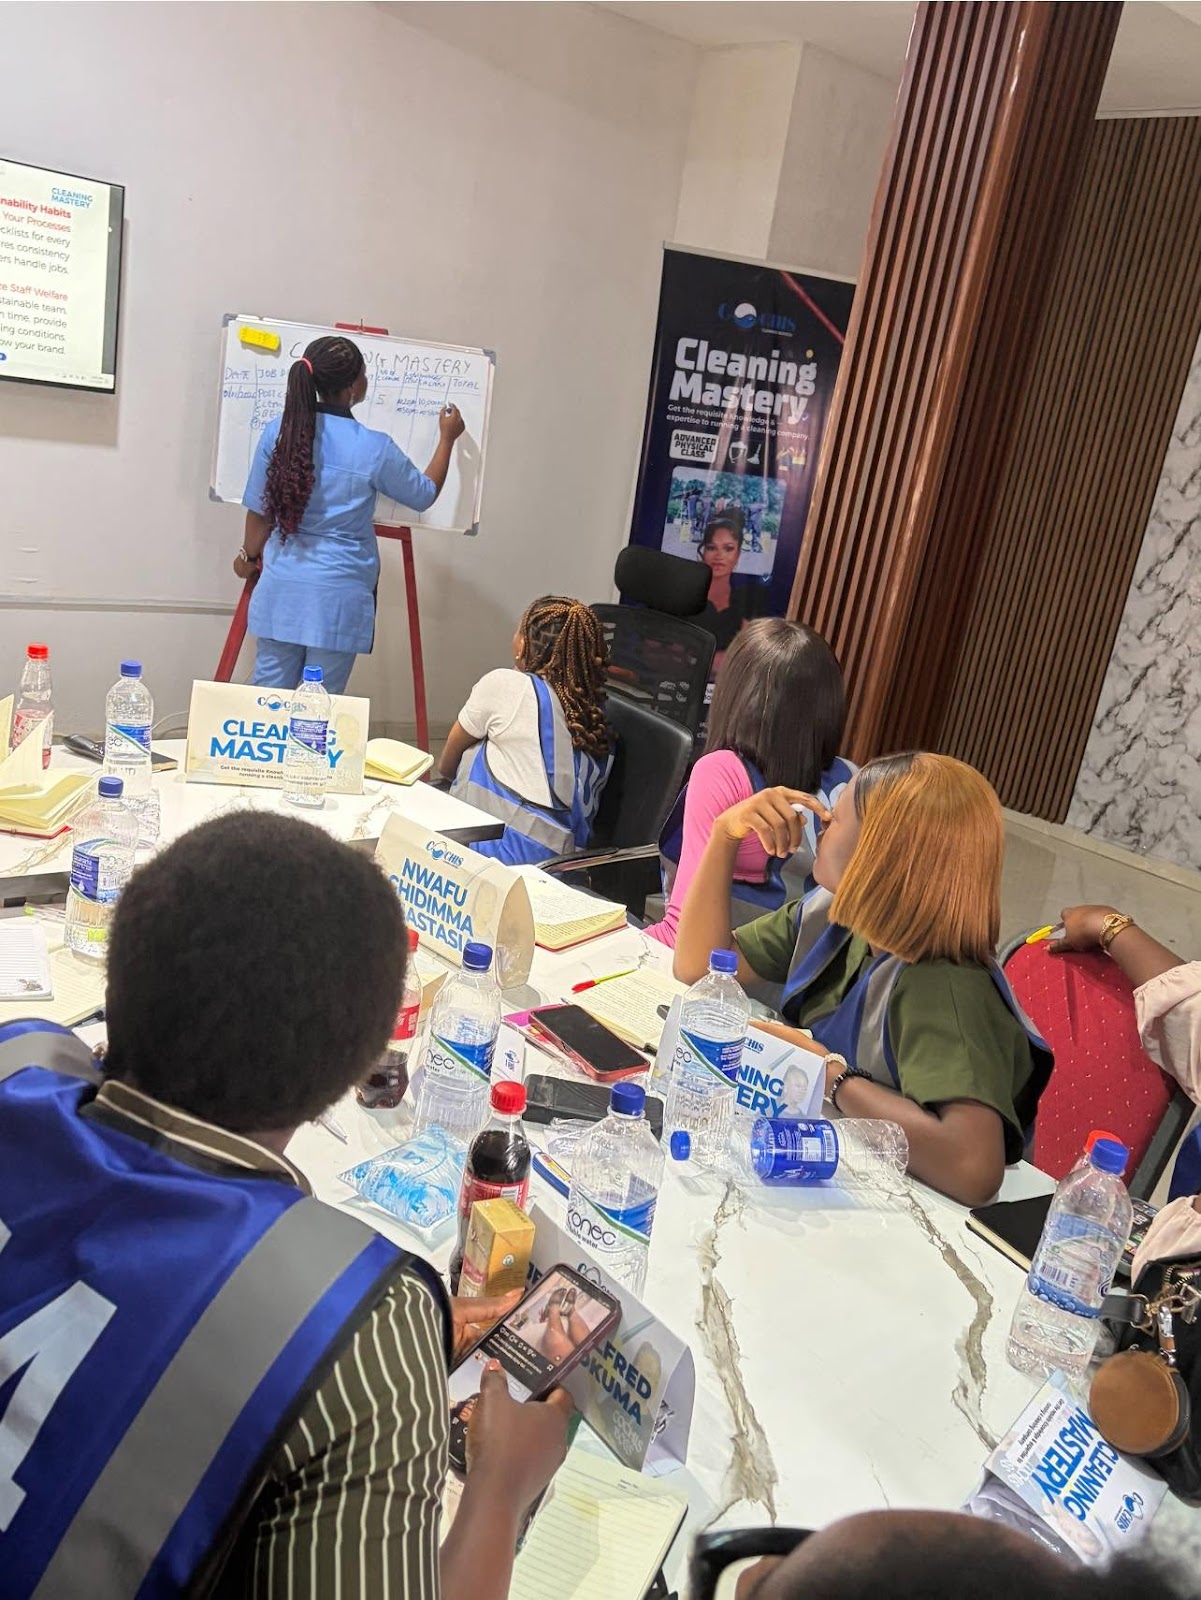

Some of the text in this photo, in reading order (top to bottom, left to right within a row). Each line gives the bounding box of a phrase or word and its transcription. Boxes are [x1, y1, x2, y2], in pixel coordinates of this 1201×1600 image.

[52, 187, 93, 202] CLEANING
[52, 194, 90, 208] MASTERY
[0, 198, 72, 218] nability Habits
[3, 210, 71, 232] Your Processes
[0, 226, 71, 248] cklists for every
[0, 241, 70, 262] res consistency
[0, 254, 69, 274] ers handle jobs.
[10, 284, 31, 294] Staff
[34, 288, 68, 301] Welfare
[0, 297, 40, 310] tainable
[0, 324, 14, 335] ing
[34, 316, 67, 328] provide
[15, 341, 34, 350] your
[394, 354, 471, 374] MASTERY
[674, 337, 818, 396] Cleaning
[258, 369, 276, 379] JOB
[454, 378, 480, 390] TOTAL
[668, 370, 808, 424] Mastery
[668, 404, 681, 413] Get
[682, 406, 696, 414] the
[696, 408, 728, 420] requisite
[666, 414, 701, 425] expertise
[702, 418, 710, 426] to
[710, 420, 740, 432] running
[746, 425, 776, 437] cleaning
[674, 433, 716, 446] ADVANCED
[674, 440, 714, 453] PHYSICAL
[680, 448, 706, 458] CLASS
[222, 719, 337, 746] CLEAG
[210, 737, 344, 768] MASTY
[402, 858, 468, 906] NWAFU
[405, 906, 472, 952] ASTASI
[742, 1036, 764, 1052] CHIS
[676, 1046, 692, 1064] ec
[739, 1064, 785, 1097] NING
[736, 1082, 788, 1119] ERY
[1017, 1428, 1032, 1446] company
[1033, 1420, 1050, 1441] Knowledge
[1017, 1456, 1023, 1464] to
[1020, 1440, 1034, 1460] expertise
[1031, 1407, 1096, 1504] MASTERY
[1063, 1440, 1119, 1522] CLEANING
